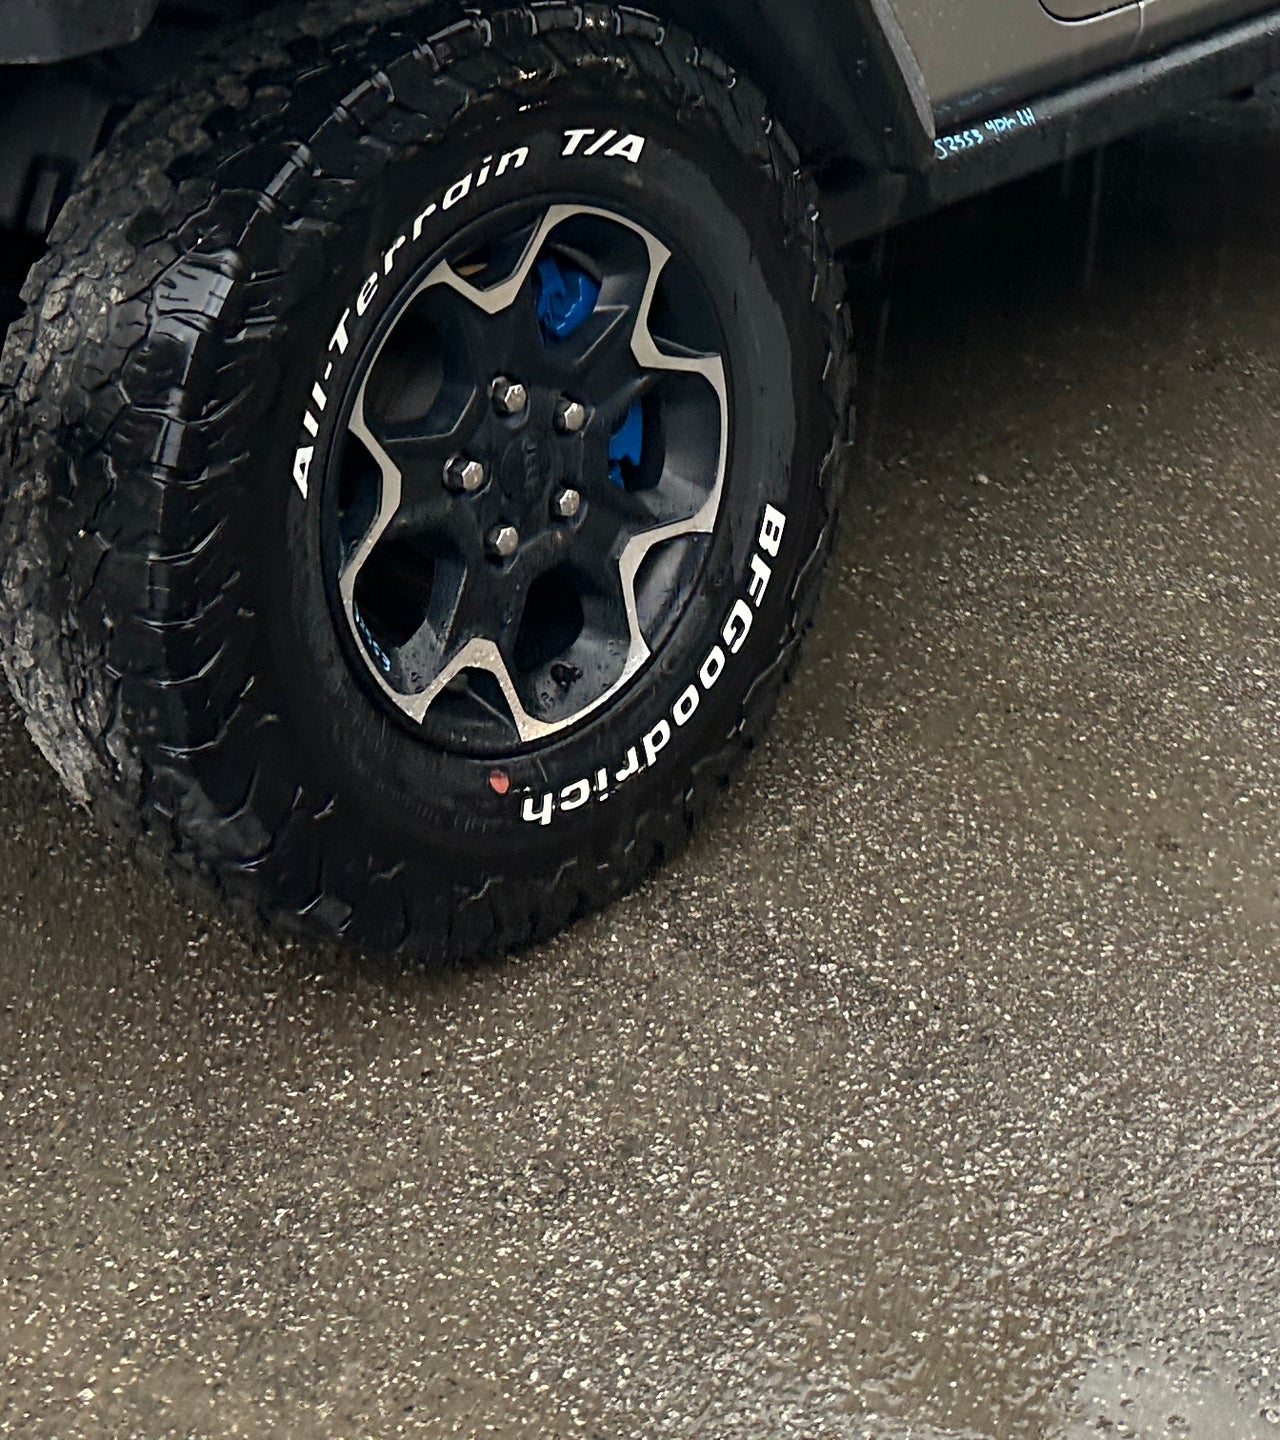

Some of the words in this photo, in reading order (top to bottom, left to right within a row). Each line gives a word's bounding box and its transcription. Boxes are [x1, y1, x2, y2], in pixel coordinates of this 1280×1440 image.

[292, 145, 530, 500] All-Terrain
[561, 127, 646, 163] T/A
[521, 503, 787, 826] BFGoodrich
